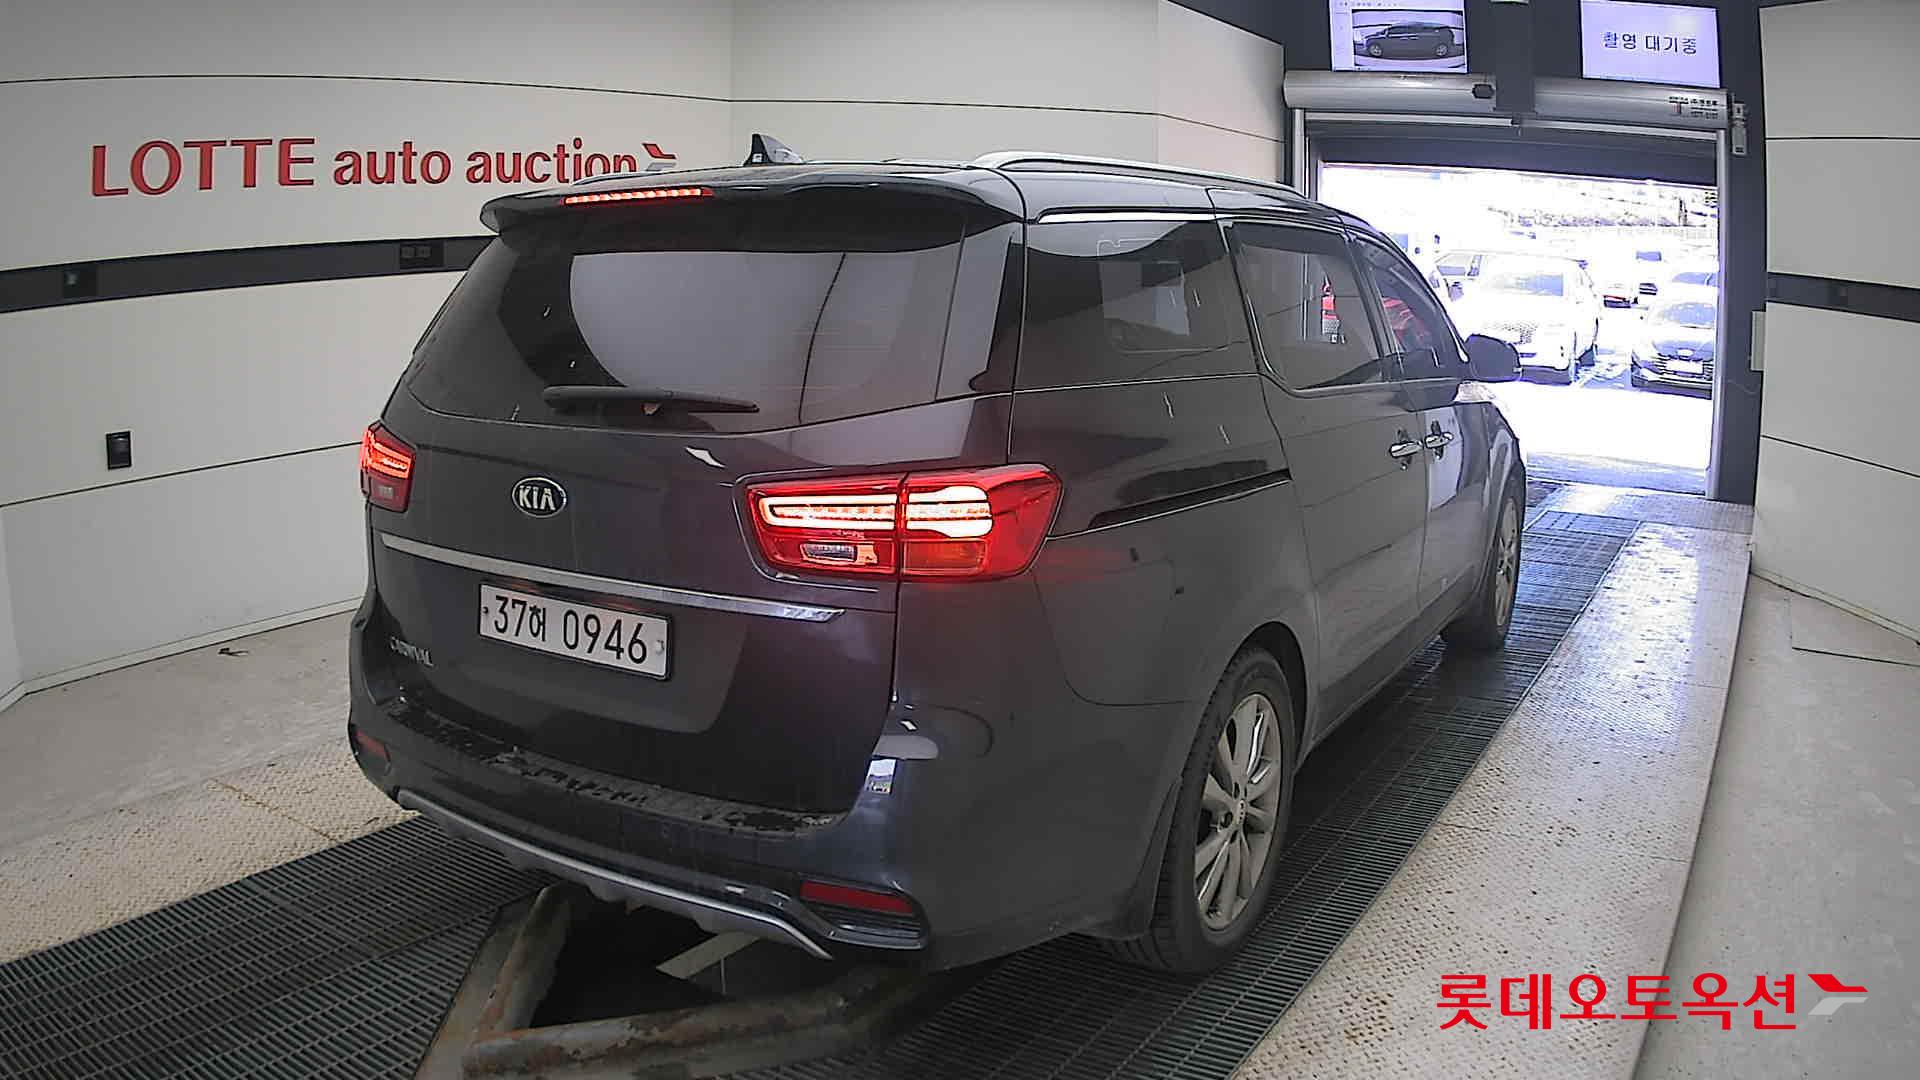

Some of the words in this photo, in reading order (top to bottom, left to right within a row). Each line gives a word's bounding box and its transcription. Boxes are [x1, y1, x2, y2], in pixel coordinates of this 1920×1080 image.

[1645, 34, 1697, 55] 대기중
[91, 137, 316, 198] LOTTE
[332, 142, 452, 186] auto
[466, 137, 638, 184] auction
[517, 484, 557, 512] KIA
[494, 595, 547, 642] 37허
[562, 609, 649, 665] 0946
